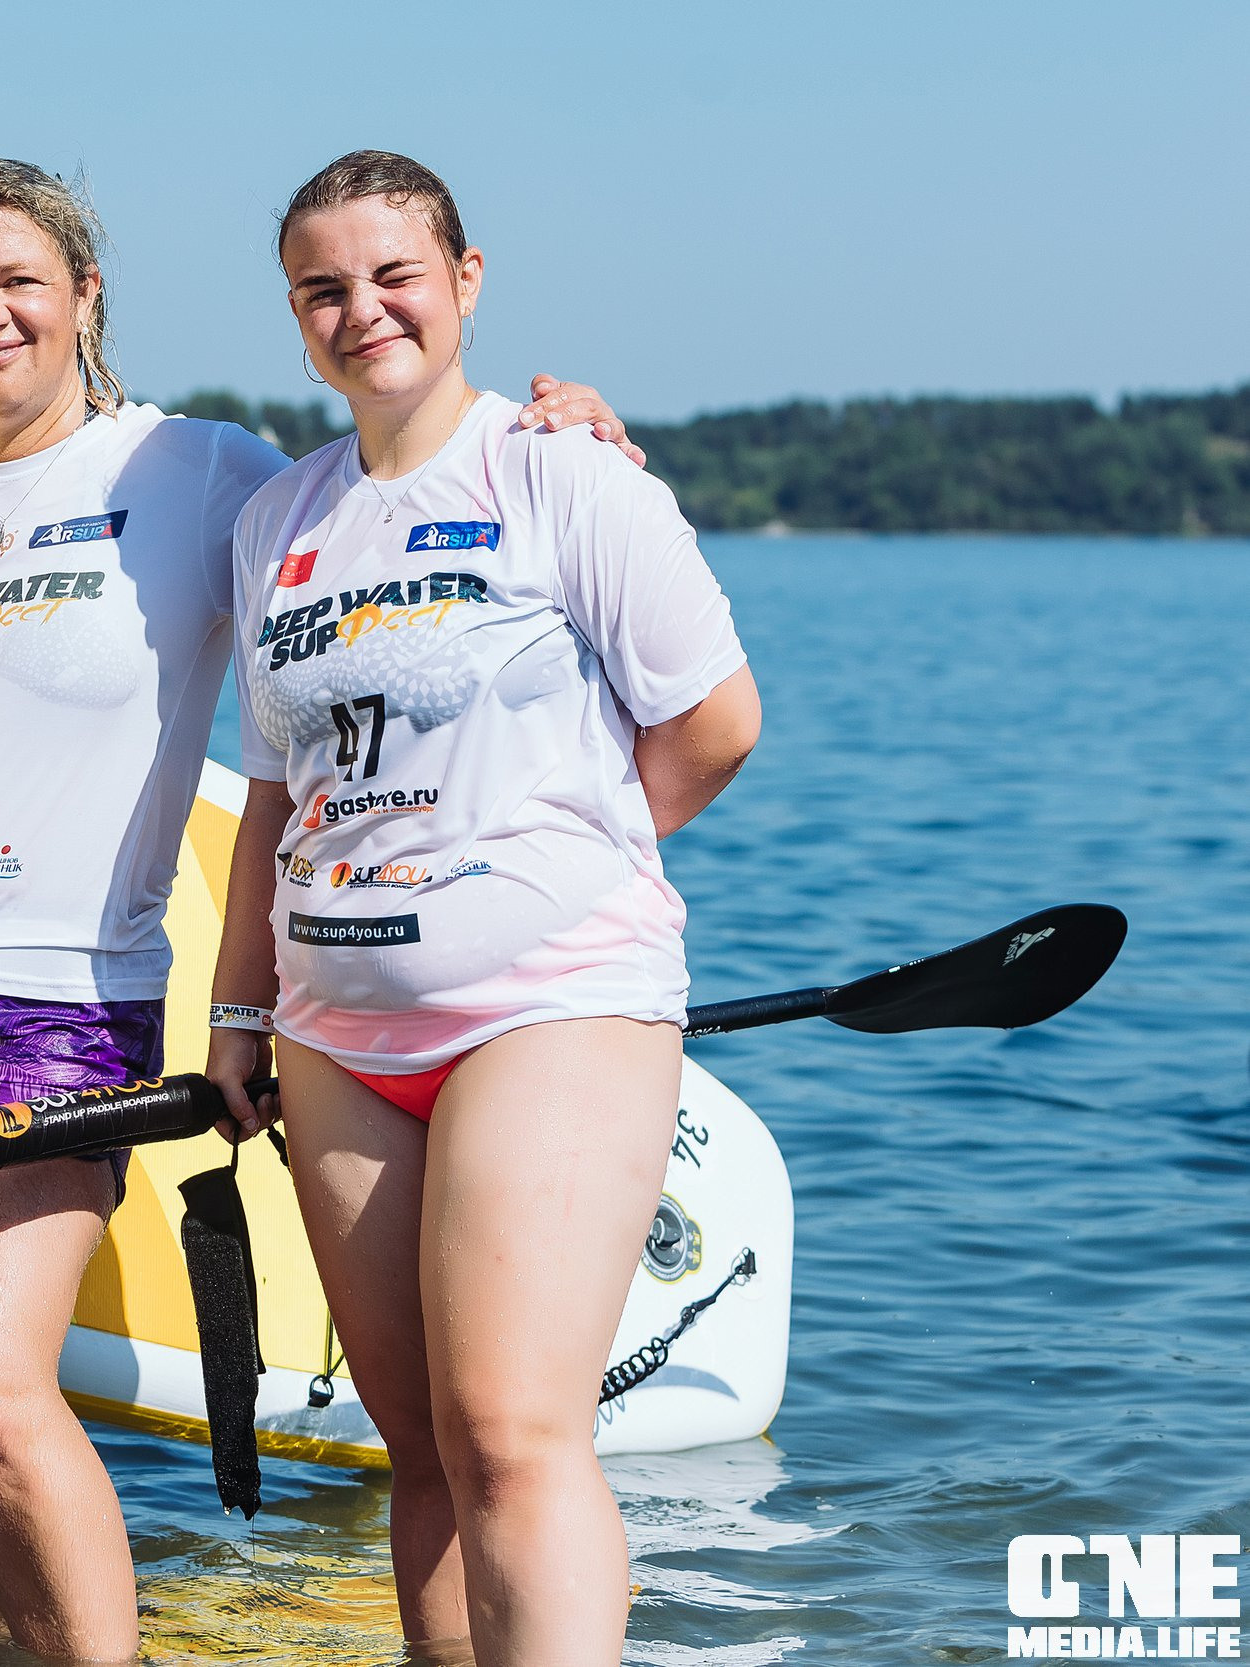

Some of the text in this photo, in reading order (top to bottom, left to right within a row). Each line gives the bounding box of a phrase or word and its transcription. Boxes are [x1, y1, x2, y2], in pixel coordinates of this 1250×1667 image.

[257, 572, 488, 647] DEEP WATER
[330, 693, 385, 781] 47
[349, 864, 427, 883] SUP4YOU
[294, 923, 404, 941] www.sup4you.ru
[222, 1006, 260, 1018] WATER
[43, 1092, 169, 1126] STAND UP PADDLE BOARDING
